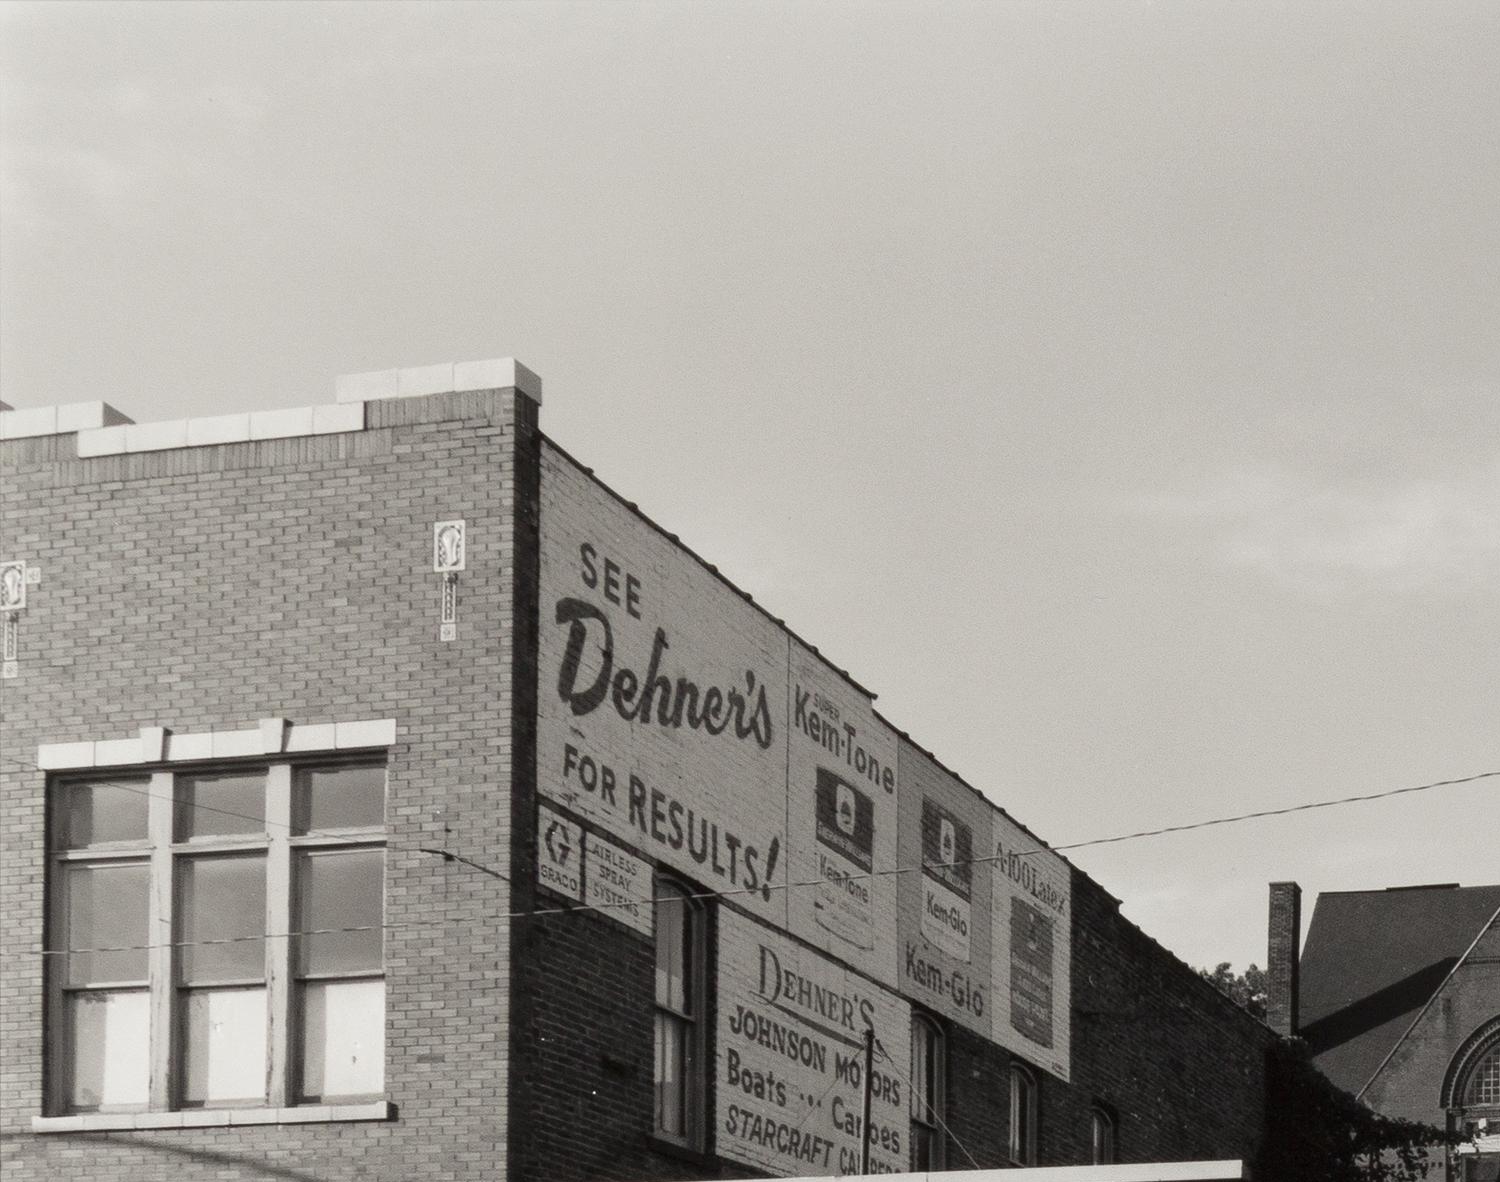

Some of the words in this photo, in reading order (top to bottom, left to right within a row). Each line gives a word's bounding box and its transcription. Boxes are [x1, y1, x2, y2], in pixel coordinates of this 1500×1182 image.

[580, 543, 641, 620] SEE
[556, 597, 772, 749] Dehner's
[795, 683, 895, 794] Kem-Tone
[813, 692, 840, 724] SUPER
[563, 743, 616, 807] FOR
[628, 773, 780, 902] RESULTS!
[541, 864, 577, 892] GRACO
[592, 843, 638, 877] AIRLESS
[599, 865, 631, 892] SPRAY
[593, 881, 640, 918] SYSTEMS
[927, 890, 967, 936] Kem-Glo
[758, 944, 875, 1034] DEHNER'S
[905, 941, 984, 1017] Kem-Glo
[727, 1047, 786, 1107] Boats
[729, 1005, 826, 1074] JOHNSON
[836, 1052, 901, 1107] MOORS
[726, 1104, 834, 1168] STARCRAFT
